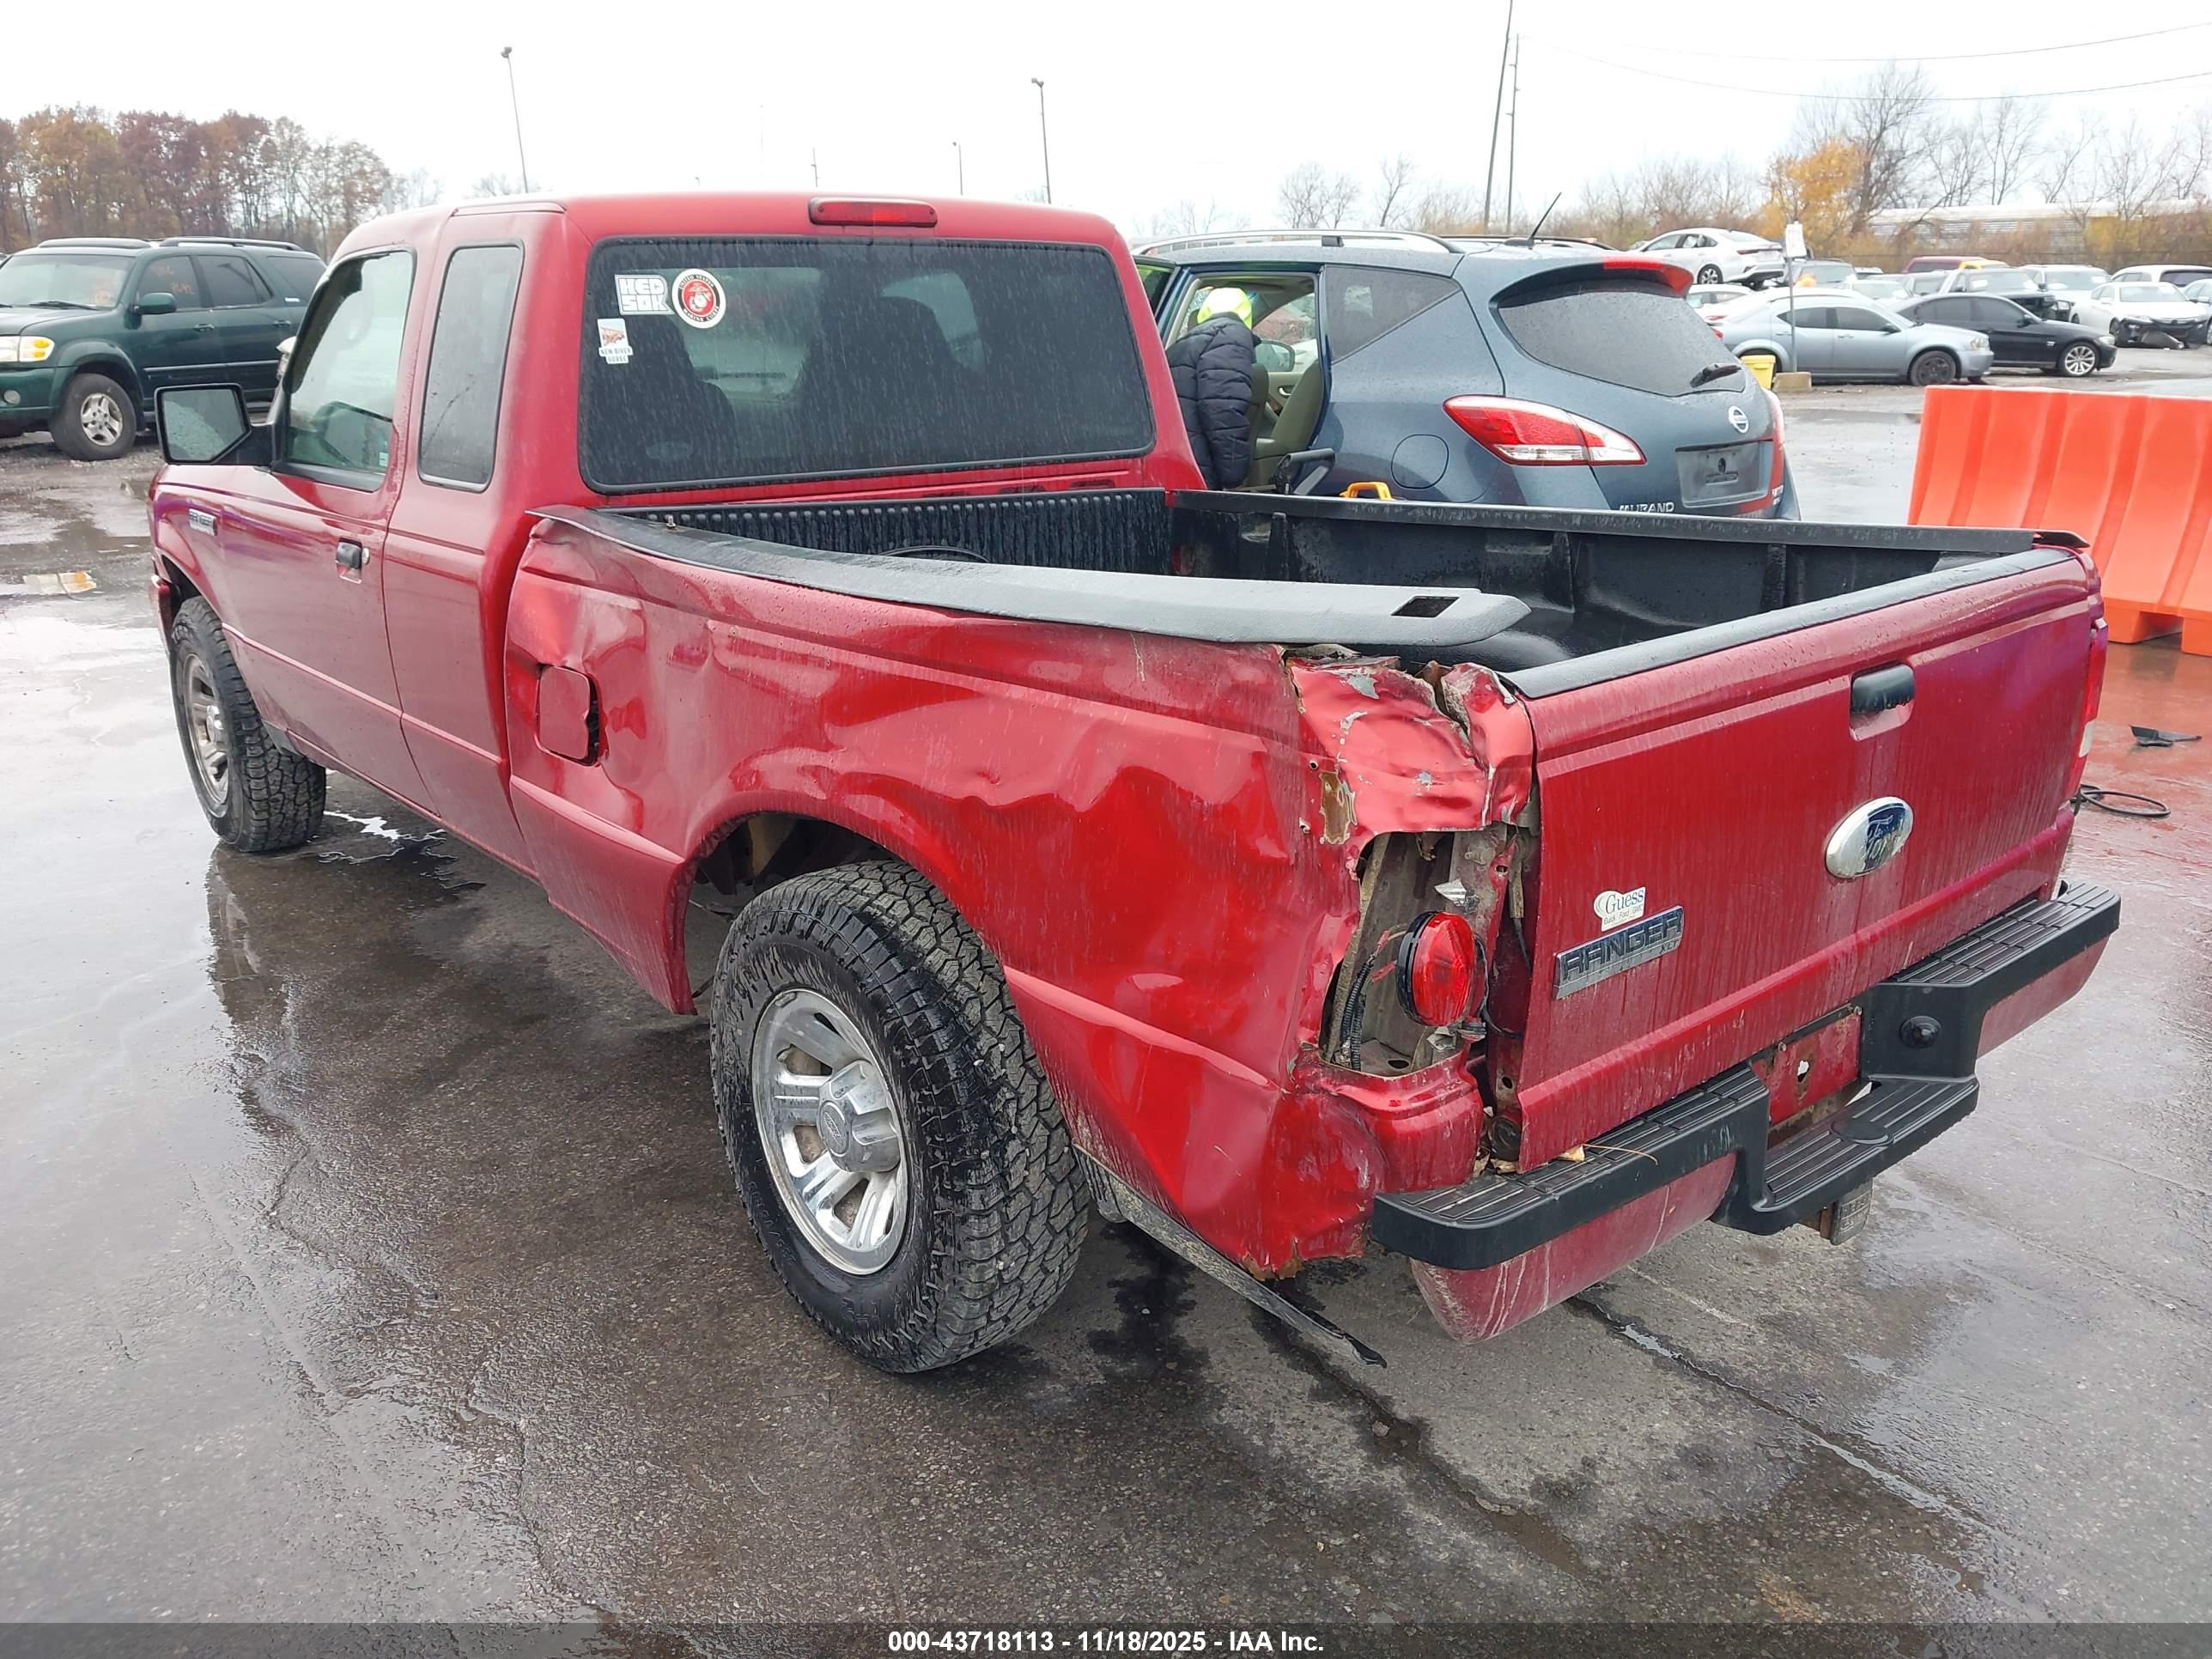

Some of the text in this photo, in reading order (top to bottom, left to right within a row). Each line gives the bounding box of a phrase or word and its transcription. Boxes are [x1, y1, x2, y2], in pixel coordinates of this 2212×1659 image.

[1605, 890, 1644, 915] Guess
[1562, 909, 1683, 981] RANGER
[1659, 939, 1680, 954] XLT
